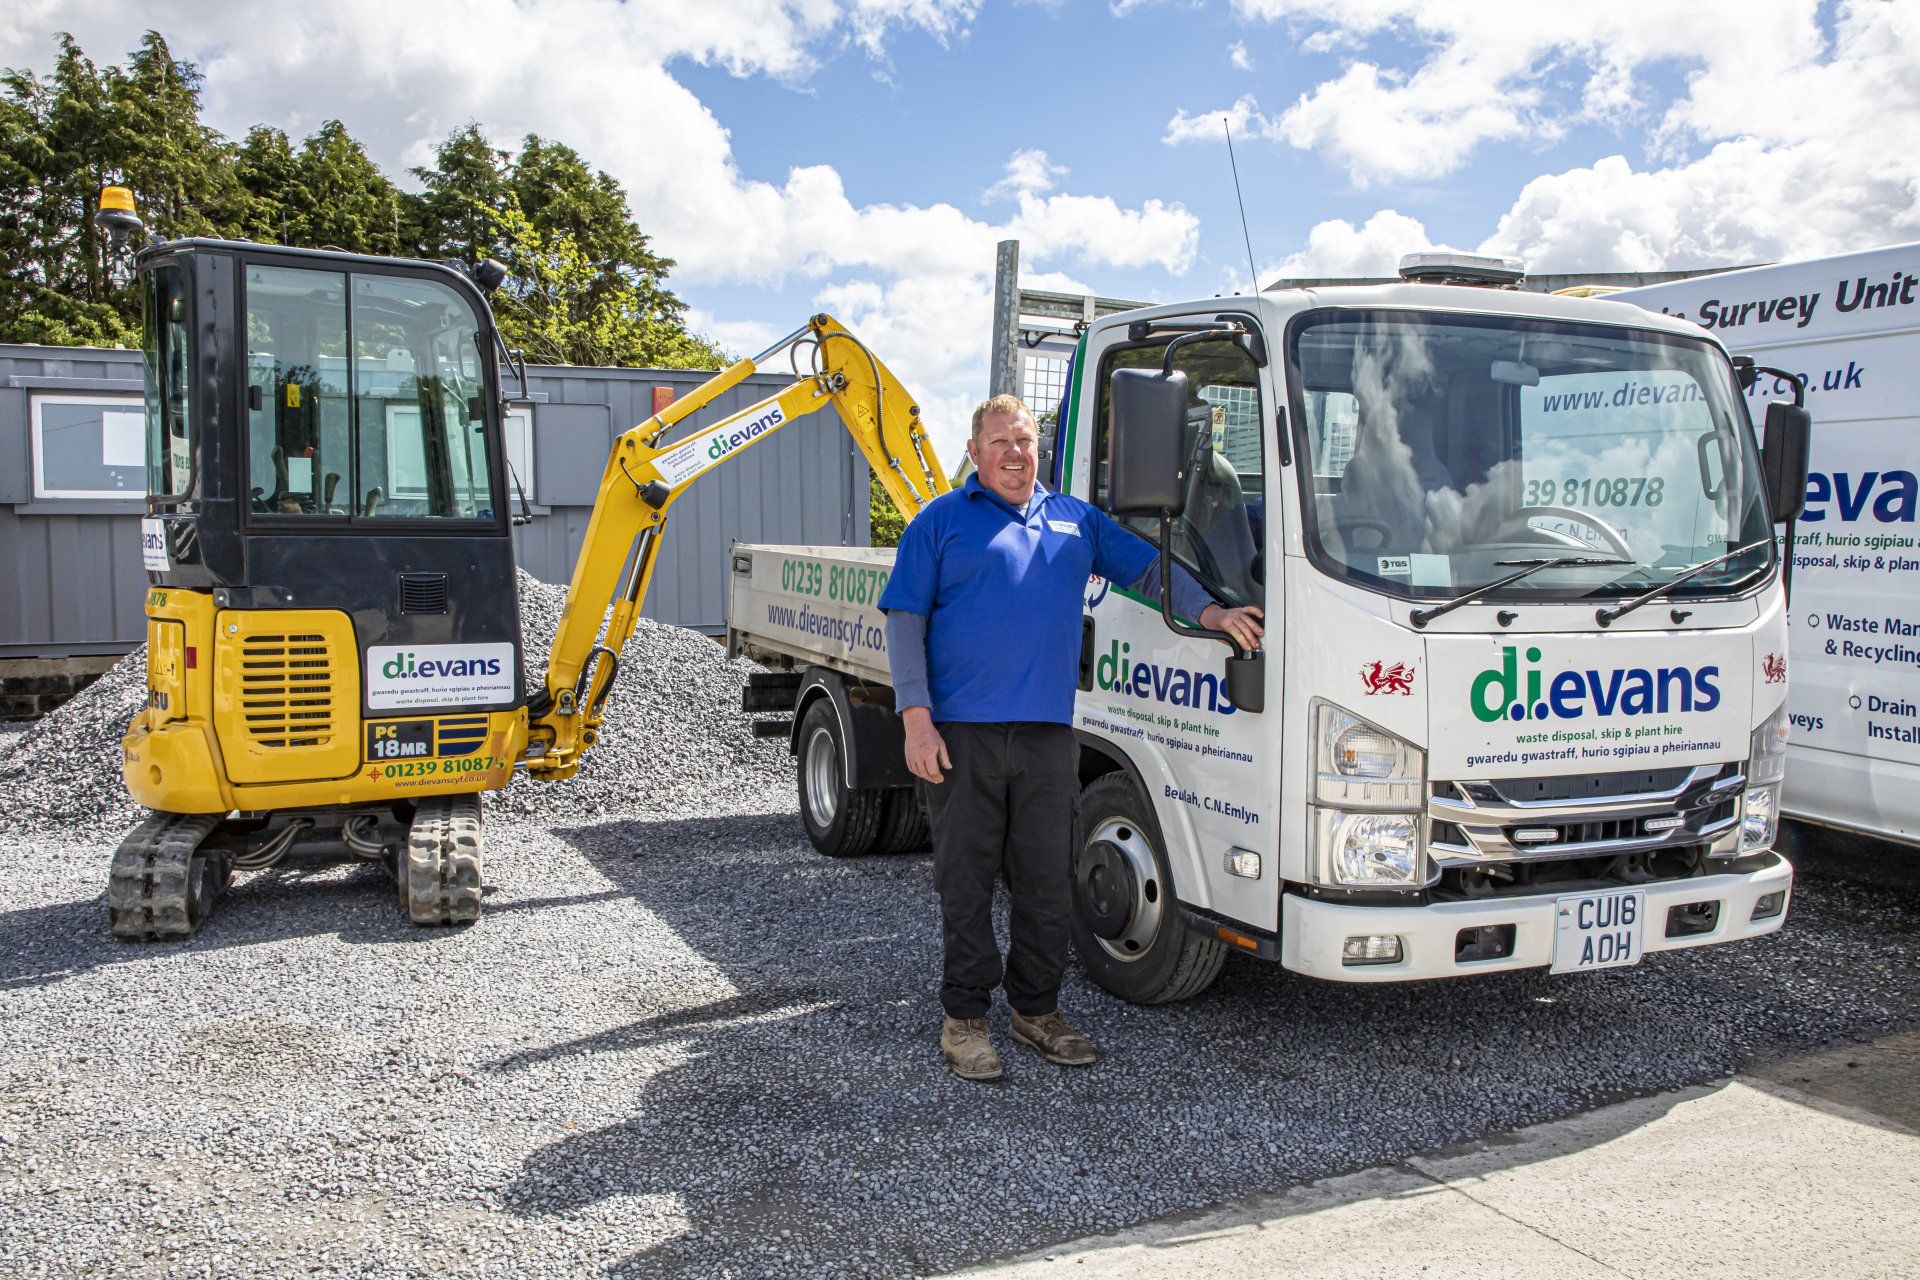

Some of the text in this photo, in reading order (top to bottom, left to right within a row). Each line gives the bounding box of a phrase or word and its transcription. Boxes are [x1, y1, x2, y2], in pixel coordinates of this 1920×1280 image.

[1696, 271, 1919, 330] Survey Unit
[1562, 477, 1665, 508] 810878
[1826, 532, 1861, 547] hurio
[1864, 534, 1914, 550] sgipiau
[1792, 553, 1840, 570] isposal,
[1843, 555, 1871, 572] skip
[1874, 556, 1885, 570] &
[1889, 556, 1920, 573] plan
[782, 558, 823, 596] 01239
[1826, 613, 1879, 634] Waste
[1825, 638, 1838, 655] &
[372, 688, 399, 696] gwaredu
[449, 686, 470, 694] sgipiau
[476, 684, 511, 692] pheiriannau
[1868, 695, 1916, 717] Drain
[375, 725, 397, 739] PC
[1107, 705, 1220, 738] waste disposal, skip & plant hire
[1082, 716, 1253, 763] gwaredu gwastraff, hurio sgipiau a pheiriannau
[1516, 725, 1683, 744] waste disposal, skip & plant hire
[374, 740, 427, 758] 18MR
[1467, 751, 1518, 767] gwaredu
[1521, 747, 1578, 764] gwastraff,
[1582, 747, 1610, 759] hurio
[1613, 744, 1650, 758] sgipiau
[1662, 740, 1721, 755] pheiriannau
[385, 762, 437, 779] 01239
[394, 776, 486, 788] www.dievanscyf.co.uk
[1164, 785, 1259, 824] Beulah, C.N.Emlyn
[1578, 894, 1636, 930] CU18
